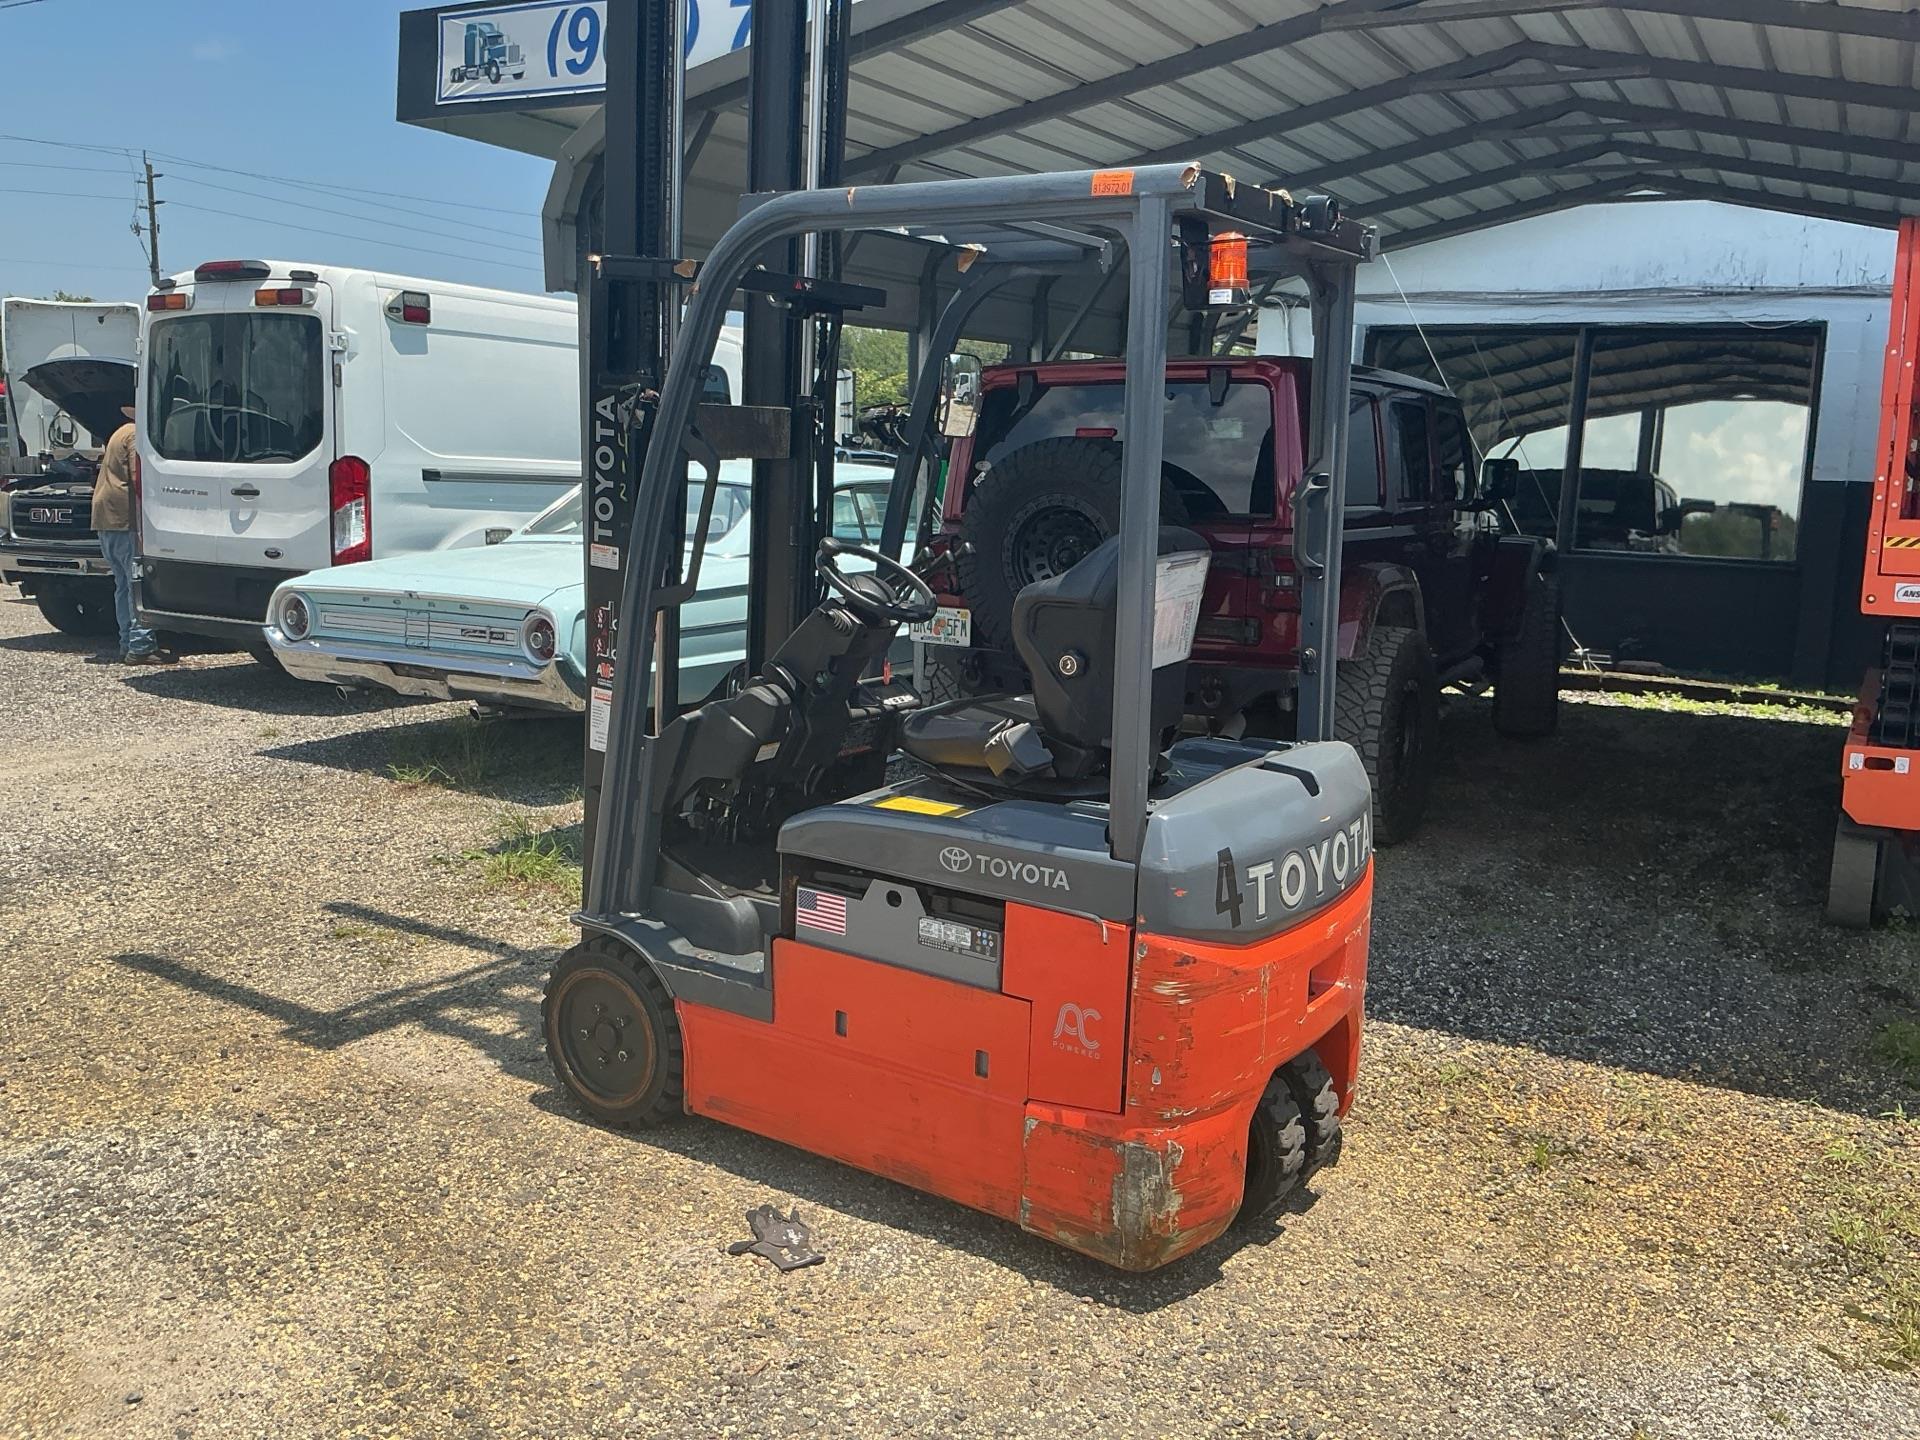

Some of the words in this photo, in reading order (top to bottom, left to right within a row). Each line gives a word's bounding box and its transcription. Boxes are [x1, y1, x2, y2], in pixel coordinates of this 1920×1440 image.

[594, 395, 616, 542] TOYOTA
[30, 507, 73, 524] GMC
[976, 854, 1071, 891] TOYOTA
[1216, 847, 1244, 929] 4
[1246, 810, 1372, 922] TOYOTA
[1053, 1003, 1102, 1049] AC
[1052, 1040, 1101, 1060] POWERED
